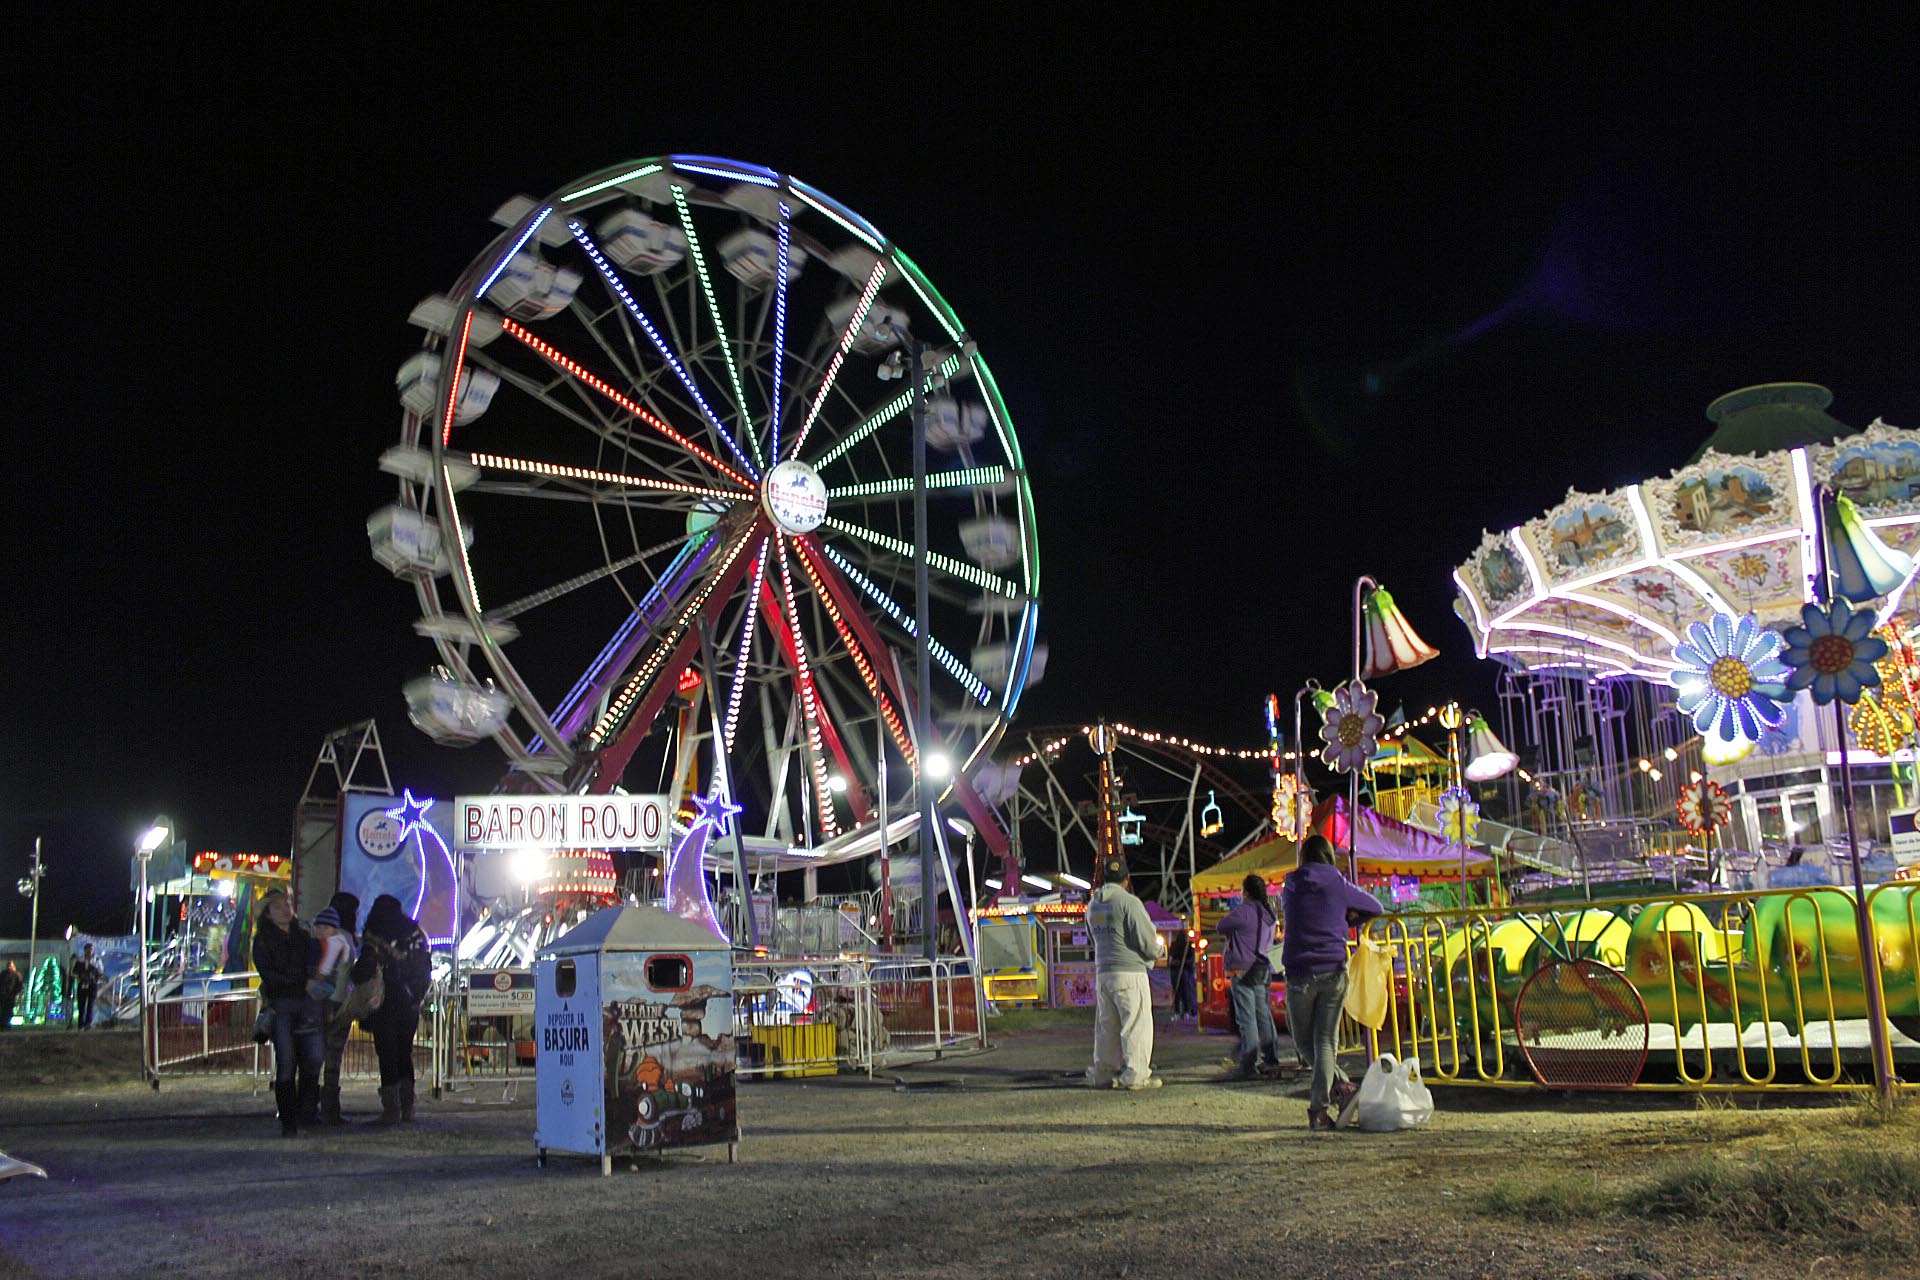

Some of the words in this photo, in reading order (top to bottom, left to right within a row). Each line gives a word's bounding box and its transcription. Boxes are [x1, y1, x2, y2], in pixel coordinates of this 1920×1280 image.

[464, 803, 568, 843] BARON
[578, 802, 662, 842] ROJO
[547, 1013, 575, 1026] DEPOSITA
[577, 1012, 585, 1026] LA
[617, 1002, 659, 1018] TRAIN
[544, 1027, 589, 1052] BASURA
[617, 1018, 680, 1049] WEST
[559, 1054, 574, 1067] AQUI
